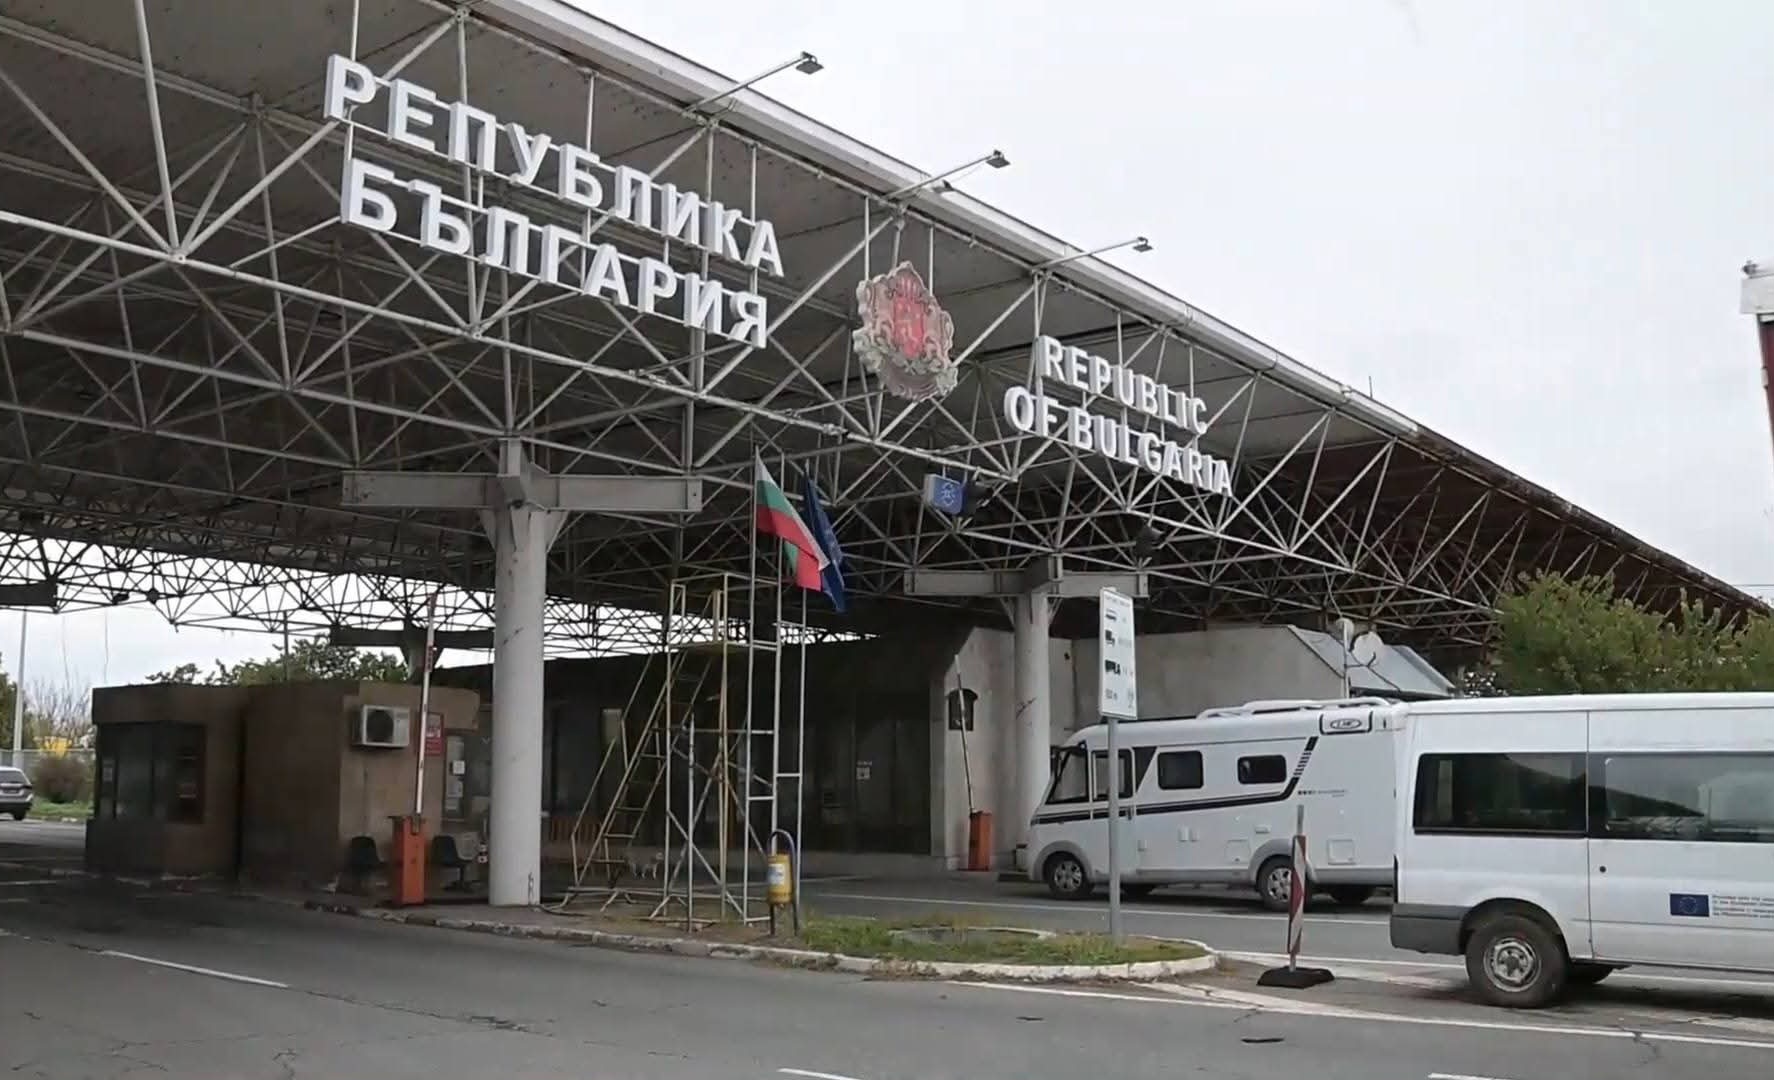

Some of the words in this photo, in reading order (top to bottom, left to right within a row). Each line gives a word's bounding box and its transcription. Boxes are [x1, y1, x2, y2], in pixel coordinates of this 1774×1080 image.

[324, 54, 784, 277] РЕПУБЛИКА
[341, 158, 767, 348] БЪЛГАРИЯ
[1004, 386, 1058, 437] OF
[1067, 407, 1232, 496] BULGARIA
[1036, 335, 1207, 434] REPUBLIC
